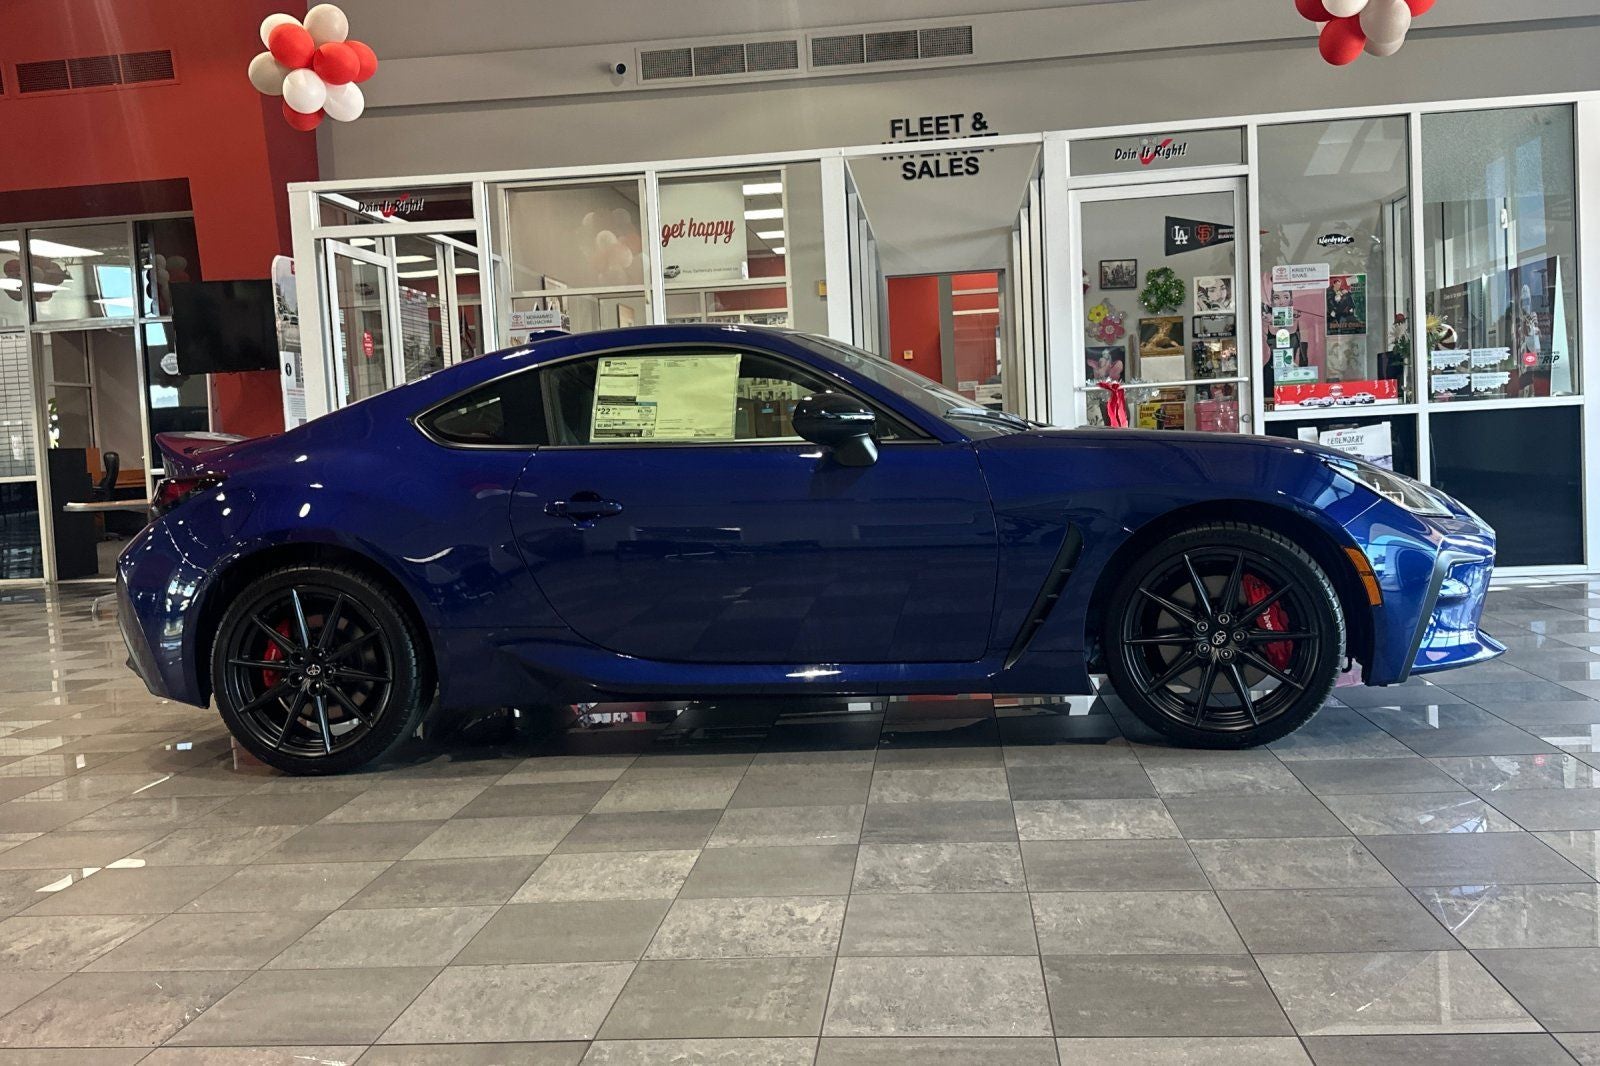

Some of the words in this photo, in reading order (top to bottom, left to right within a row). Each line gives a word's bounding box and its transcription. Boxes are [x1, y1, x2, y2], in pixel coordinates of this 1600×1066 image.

[890, 113, 964, 138] FLEET
[972, 111, 988, 131] &
[1141, 146, 1150, 159] It
[1153, 142, 1188, 160] Right!
[902, 156, 980, 181] SALES
[661, 218, 686, 248] get
[687, 217, 736, 244] happy
[1174, 225, 1189, 245] LA
